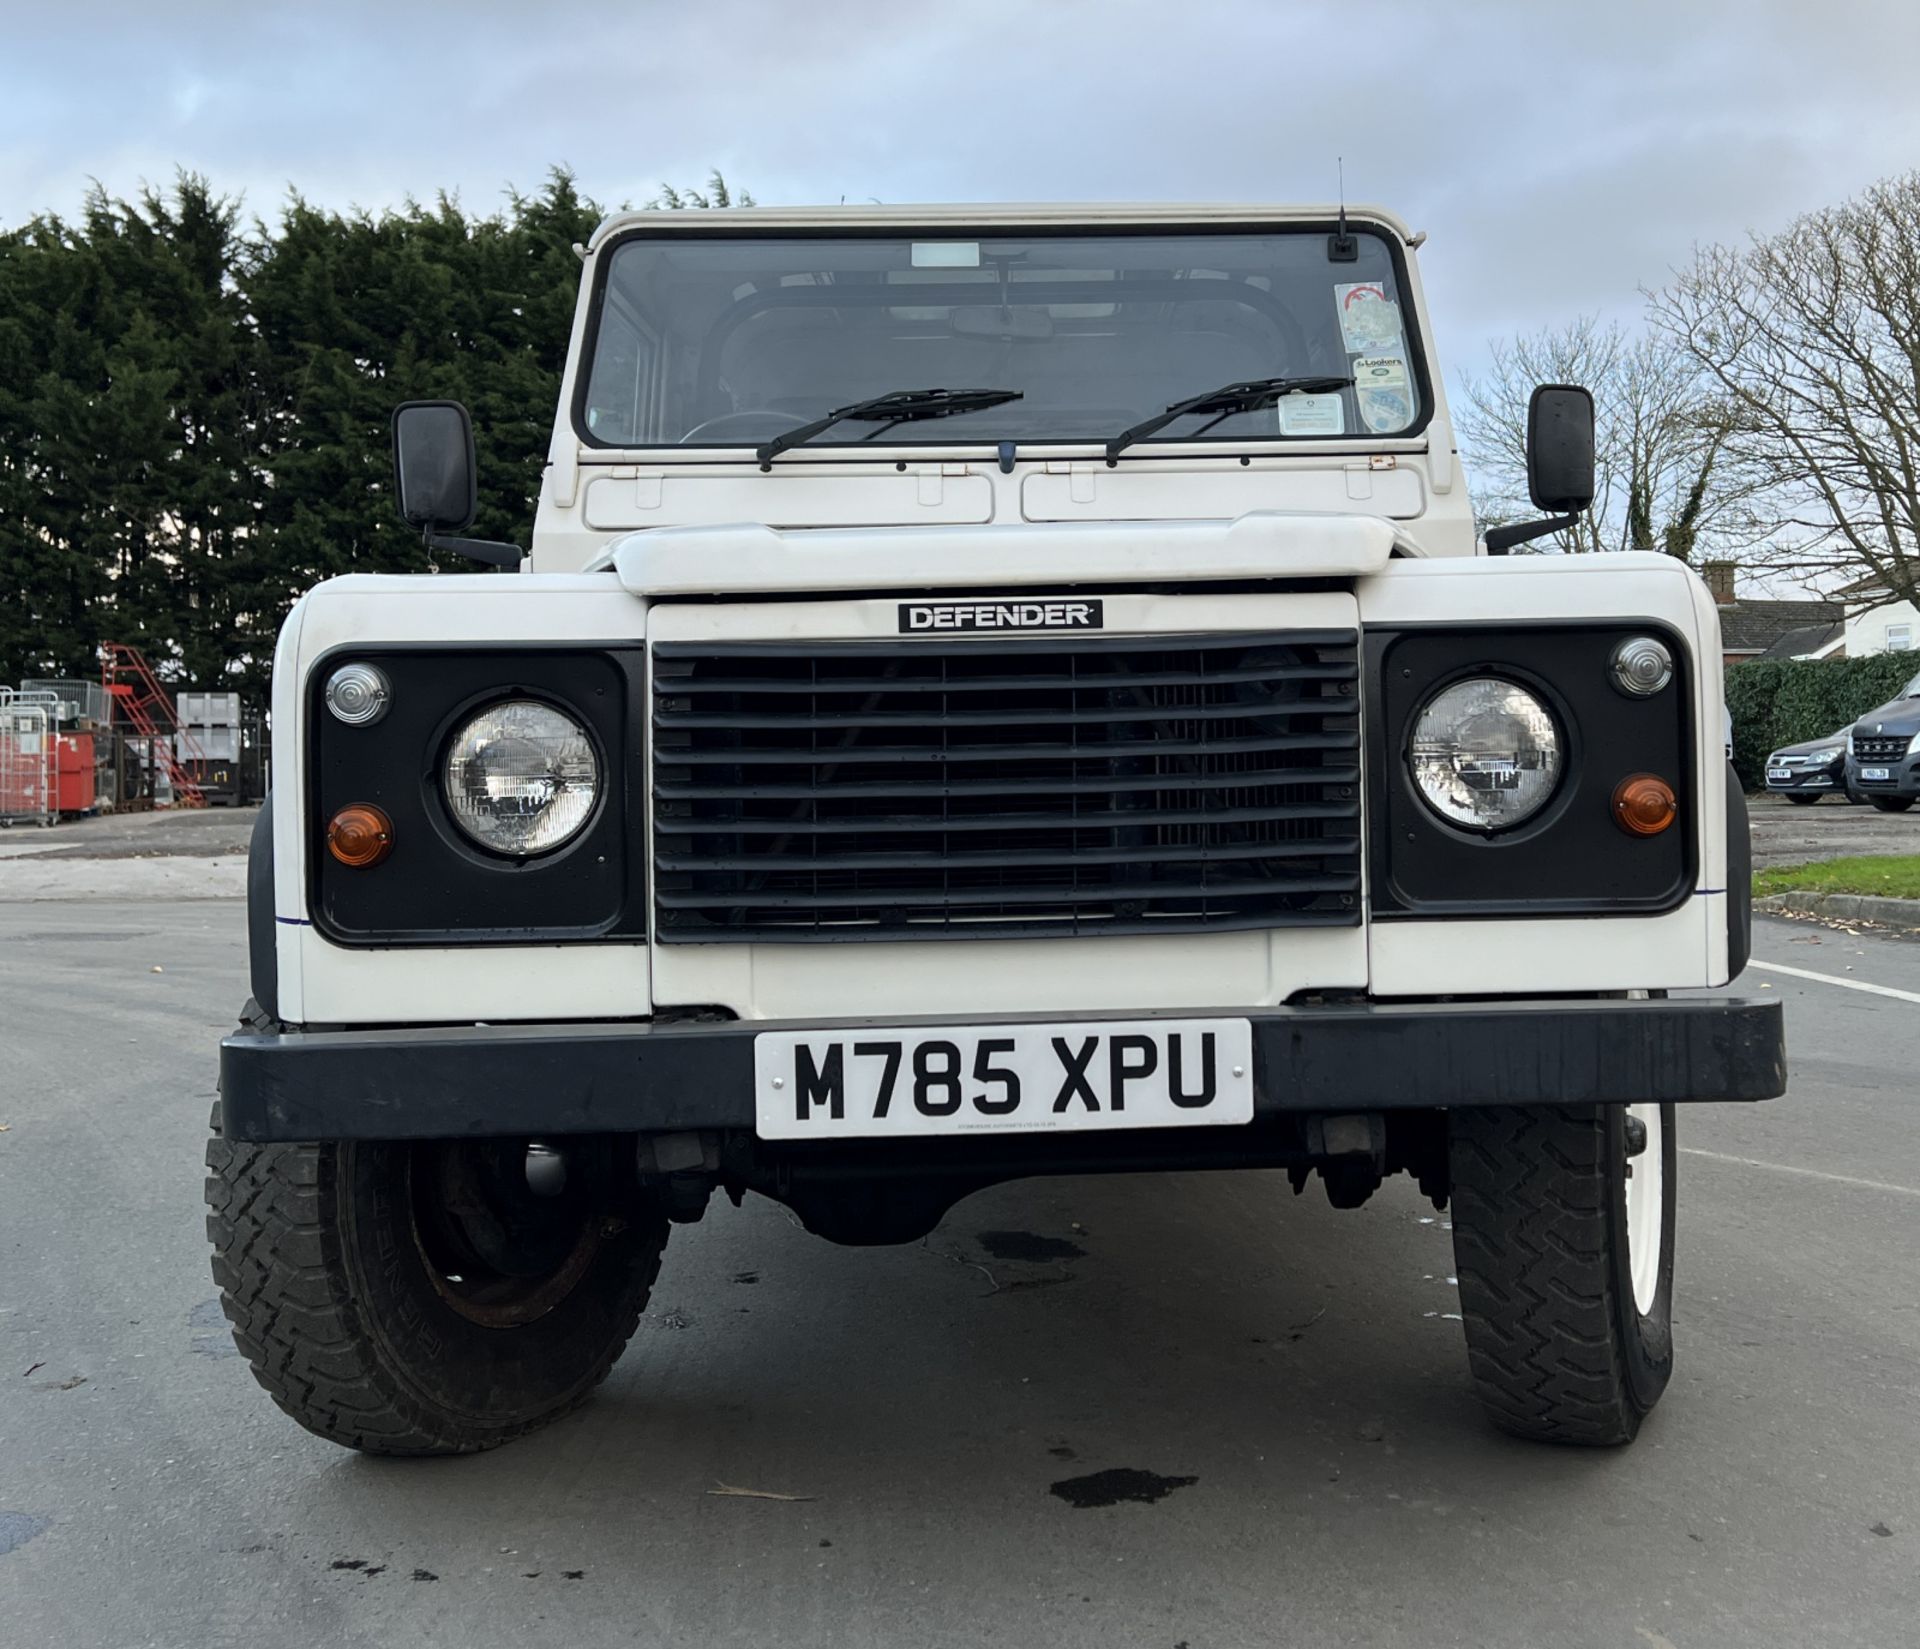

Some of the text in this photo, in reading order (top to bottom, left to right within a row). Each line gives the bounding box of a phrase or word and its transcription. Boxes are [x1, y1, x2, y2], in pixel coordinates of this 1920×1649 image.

[909, 603, 1095, 629] DEFENDER
[795, 1032, 1217, 1120] M785 XPU
